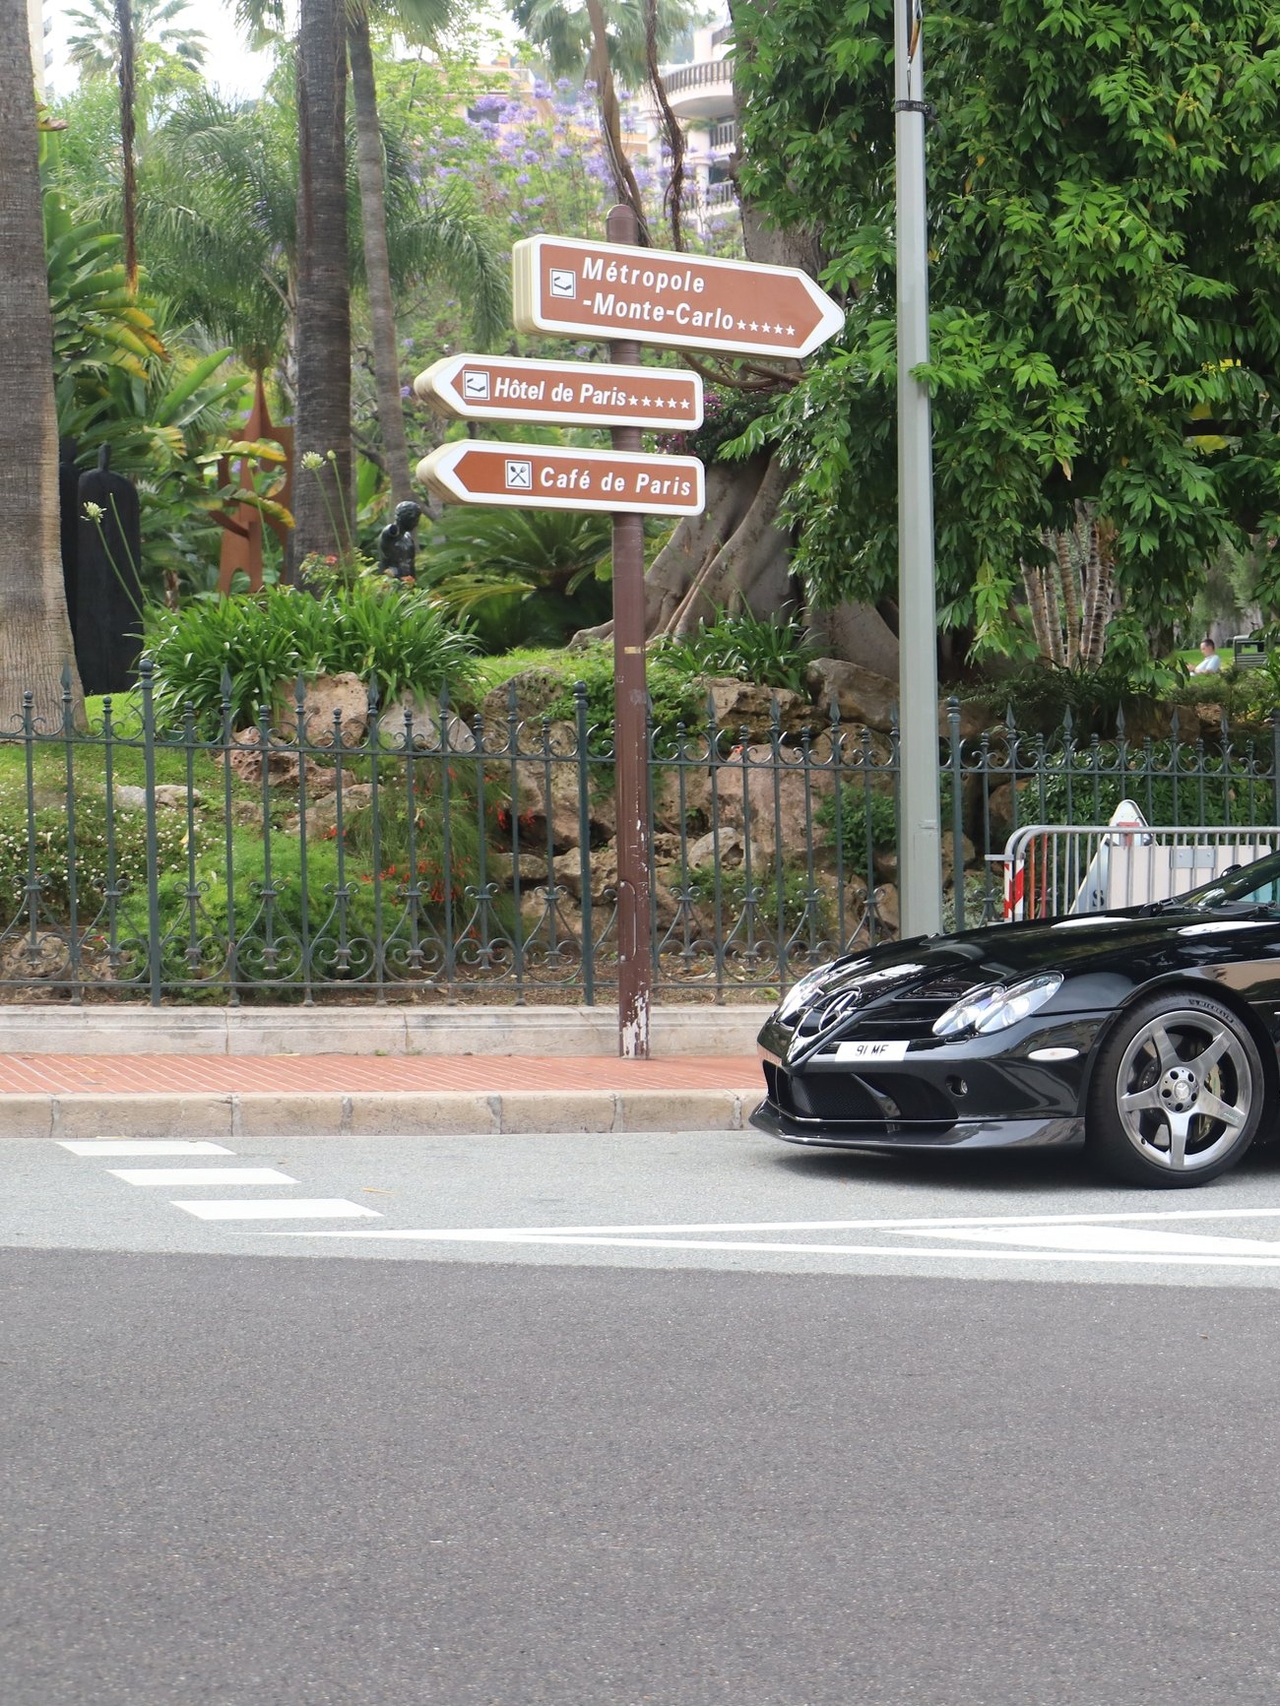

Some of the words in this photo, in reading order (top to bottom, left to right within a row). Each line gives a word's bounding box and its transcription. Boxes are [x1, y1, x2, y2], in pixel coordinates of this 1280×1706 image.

[582, 257, 705, 294] Métropole
[583, 292, 734, 331] -Monte-Carlo
[494, 377, 545, 400] Hôtel
[551, 382, 574, 402] de
[579, 383, 627, 406] Paris
[540, 466, 591, 489] Café
[601, 472, 625, 492] de
[635, 473, 691, 496] Paris
